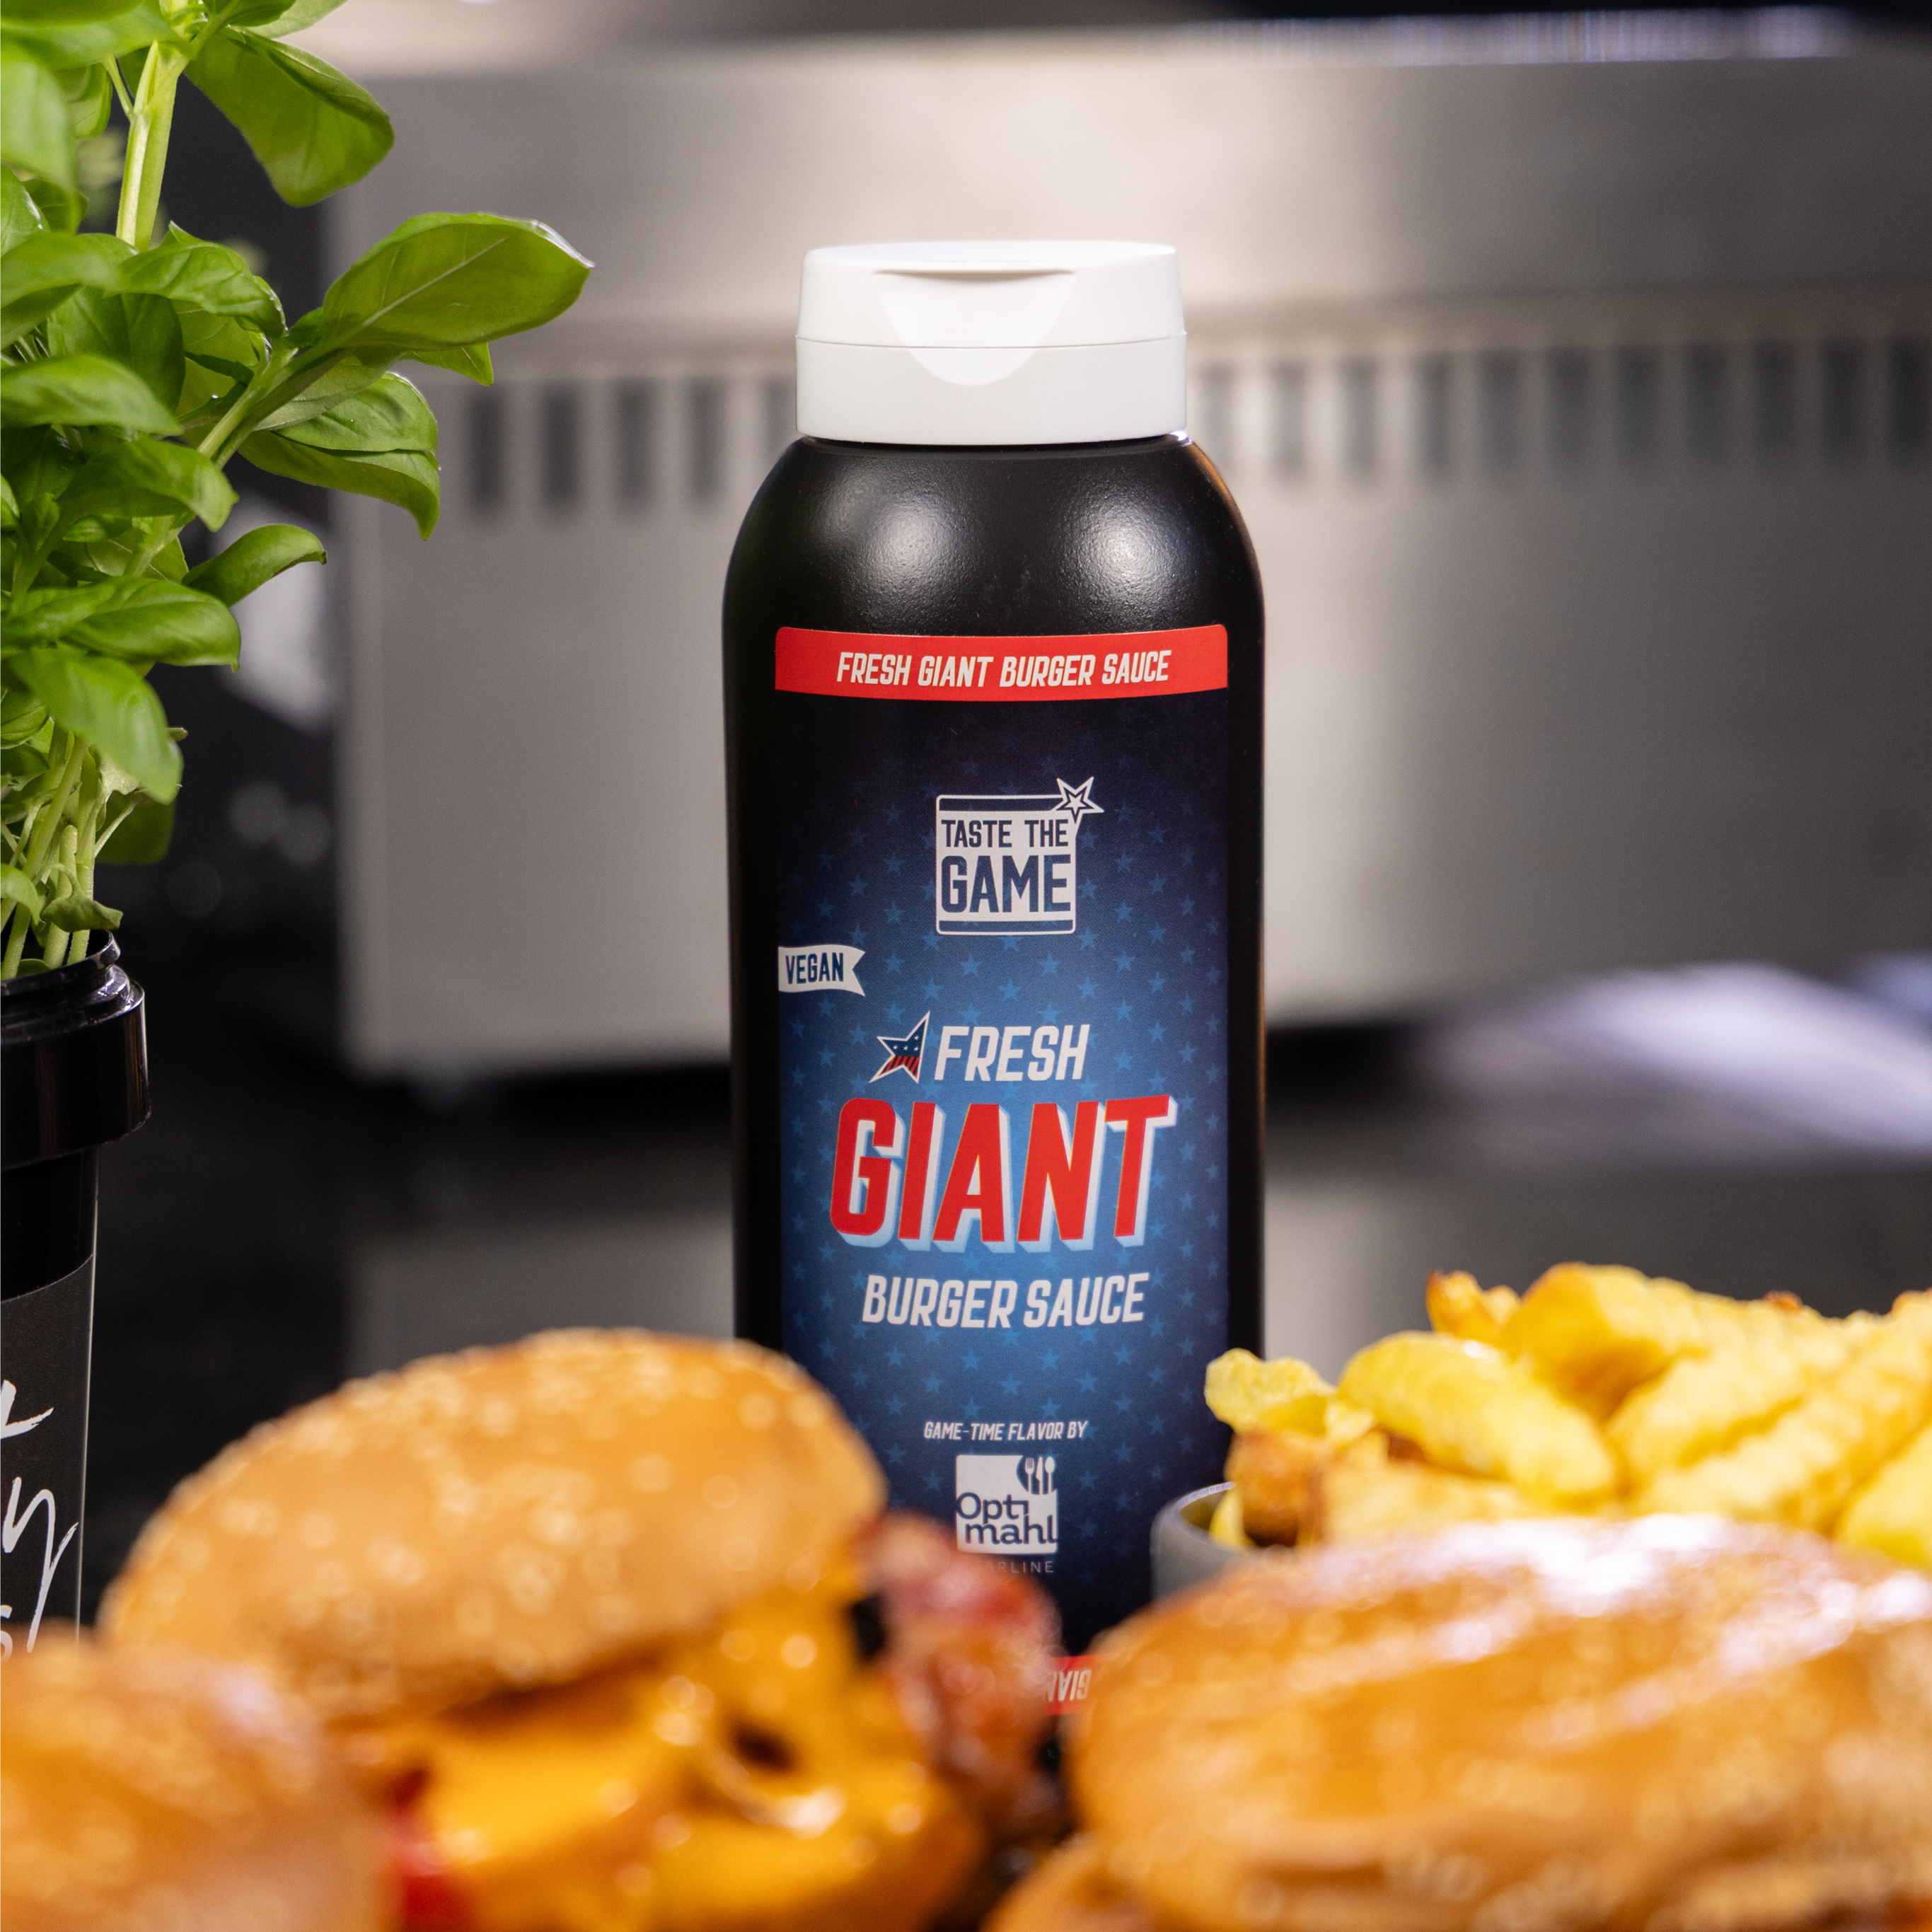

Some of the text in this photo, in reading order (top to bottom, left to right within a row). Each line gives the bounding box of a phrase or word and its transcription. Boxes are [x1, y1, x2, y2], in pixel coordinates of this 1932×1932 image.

[837, 649, 1172, 688] FRESH GIANT BURGER SAUCE
[941, 819, 1069, 848] TASTE THE
[941, 854, 1071, 913] GAME
[785, 952, 844, 985] VEGAN
[934, 1024, 1090, 1082] FRESH
[830, 1094, 1177, 1253] GIANT
[862, 1272, 1150, 1328] BURGER SAUCE
[923, 1421, 1088, 1440] GAME-TIME FLAVOR BY
